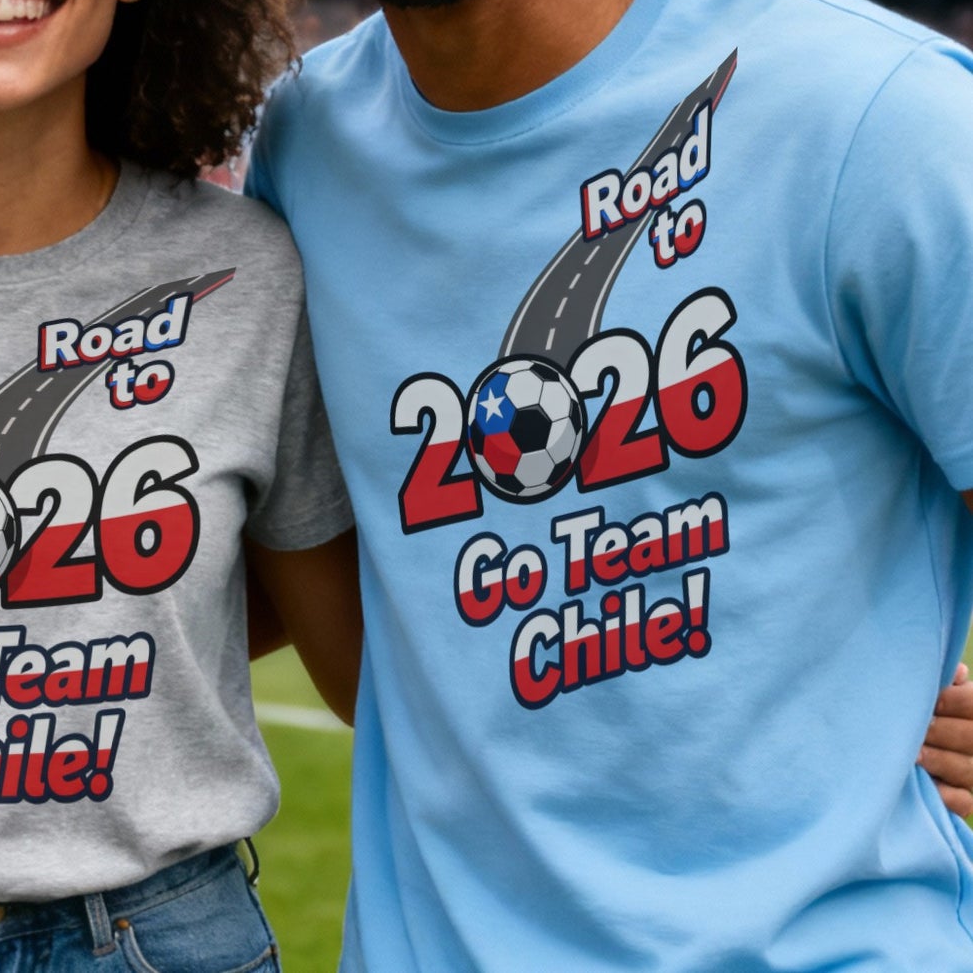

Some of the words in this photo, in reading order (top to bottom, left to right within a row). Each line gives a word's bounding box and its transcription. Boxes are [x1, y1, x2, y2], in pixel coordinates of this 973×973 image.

[580, 101, 712, 241] Road
[649, 199, 706, 269] to
[37, 292, 193, 371] Road
[105, 359, 174, 409] to
[390, 286, 748, 535] 2026
[454, 530, 547, 627] Go
[551, 491, 729, 597] Team
[509, 567, 712, 710] Chile!
